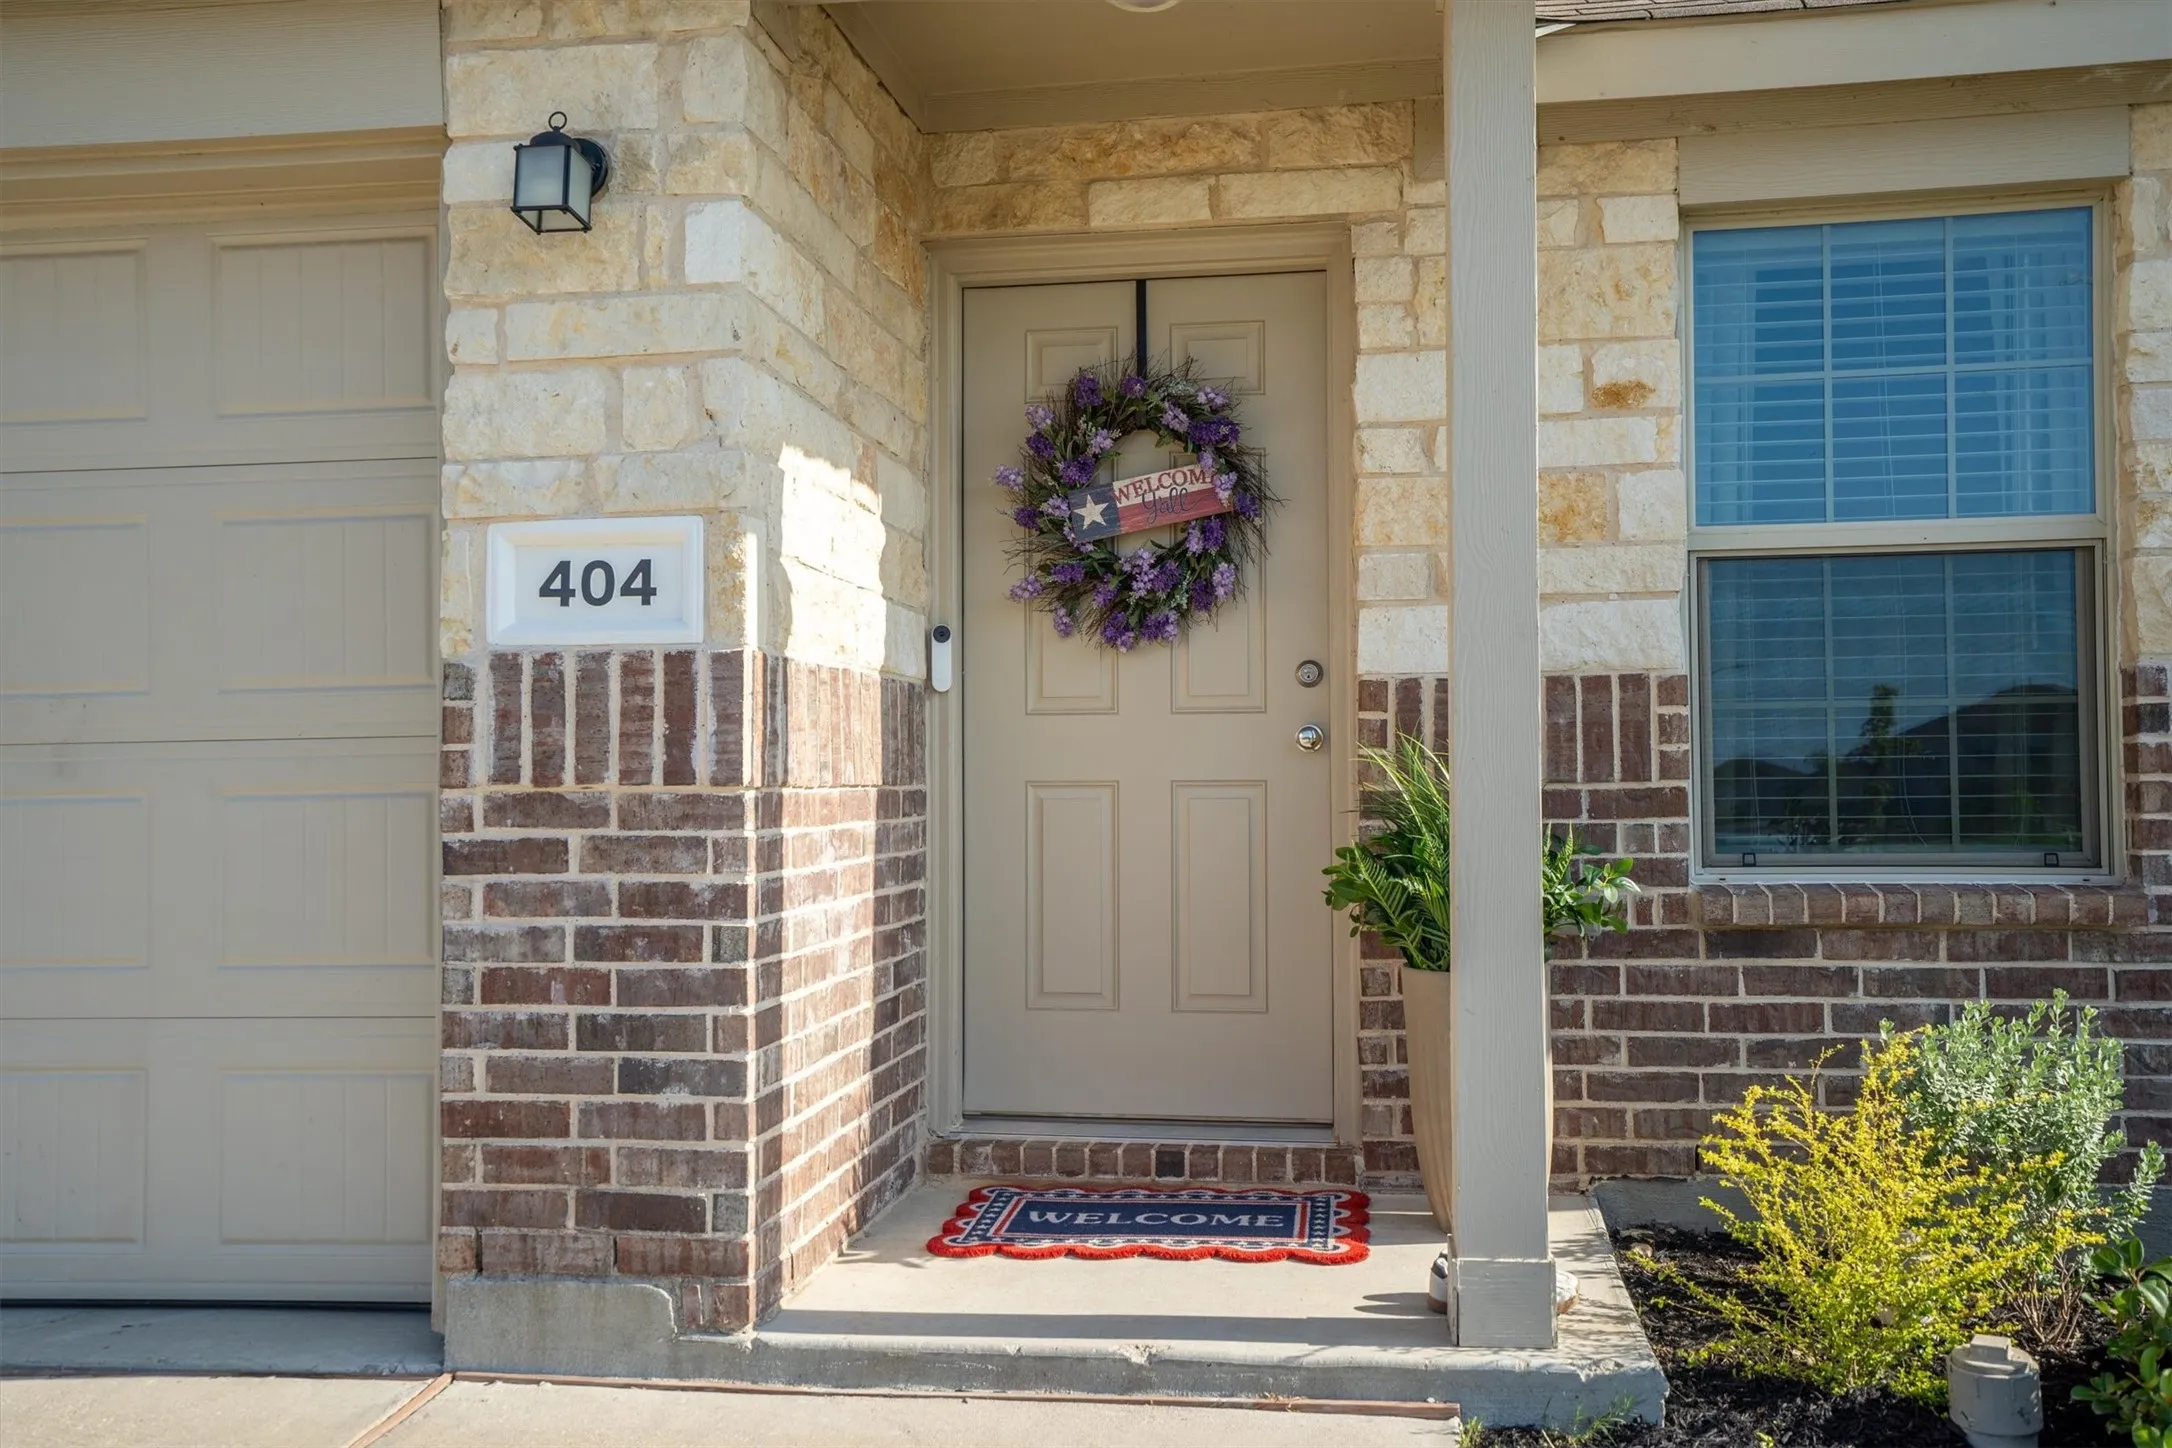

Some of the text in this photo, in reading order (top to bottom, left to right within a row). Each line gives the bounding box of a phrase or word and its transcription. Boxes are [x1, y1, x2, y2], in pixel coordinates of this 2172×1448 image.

[1112, 467, 1216, 505] WELCOM
[538, 558, 658, 608] 404
[1028, 1210, 1285, 1228] WELCOME
